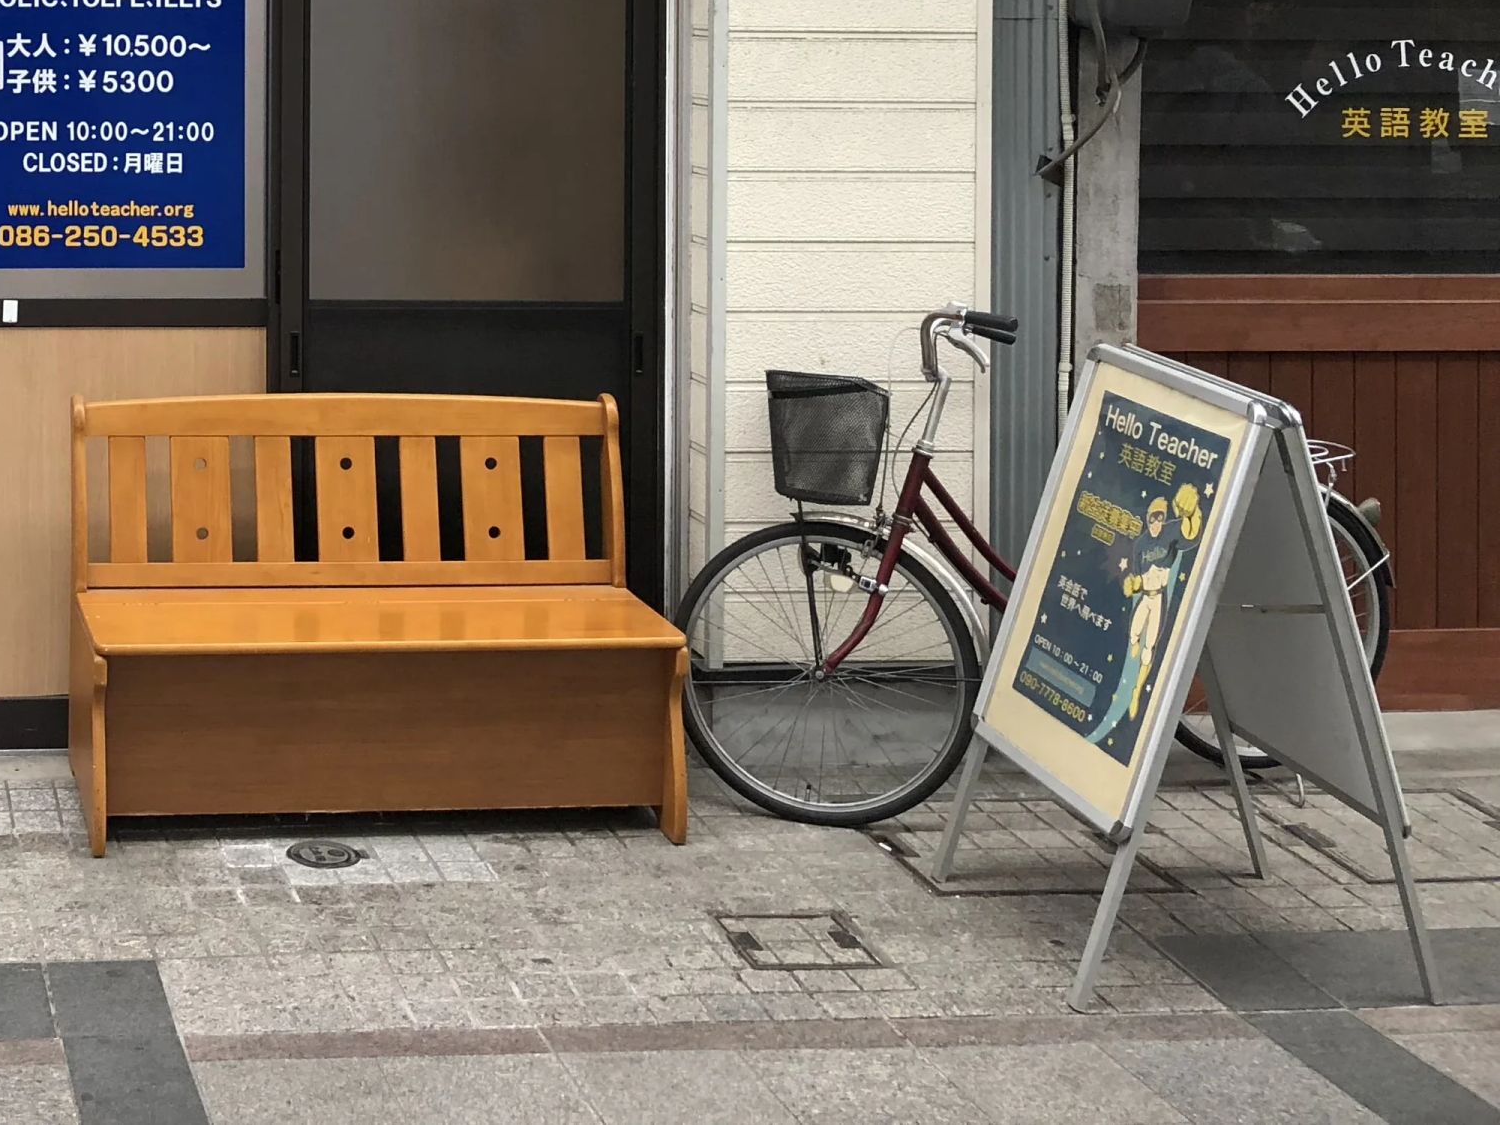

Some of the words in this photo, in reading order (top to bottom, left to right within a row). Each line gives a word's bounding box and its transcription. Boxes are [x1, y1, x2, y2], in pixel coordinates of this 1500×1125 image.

[1285, 51, 1382, 118] Hello
[1391, 39, 1500, 96] Teach
[1342, 108, 1488, 138] 英語教室
[8, 200, 194, 219] www.helloteacher.org
[1105, 405, 1143, 440] Hello
[1149, 422, 1218, 470] Teacher
[1118, 442, 1177, 486] 英語教室
[1034, 634, 1051, 651] OPEN
[1019, 671, 1087, 723] 090-7778-8600
